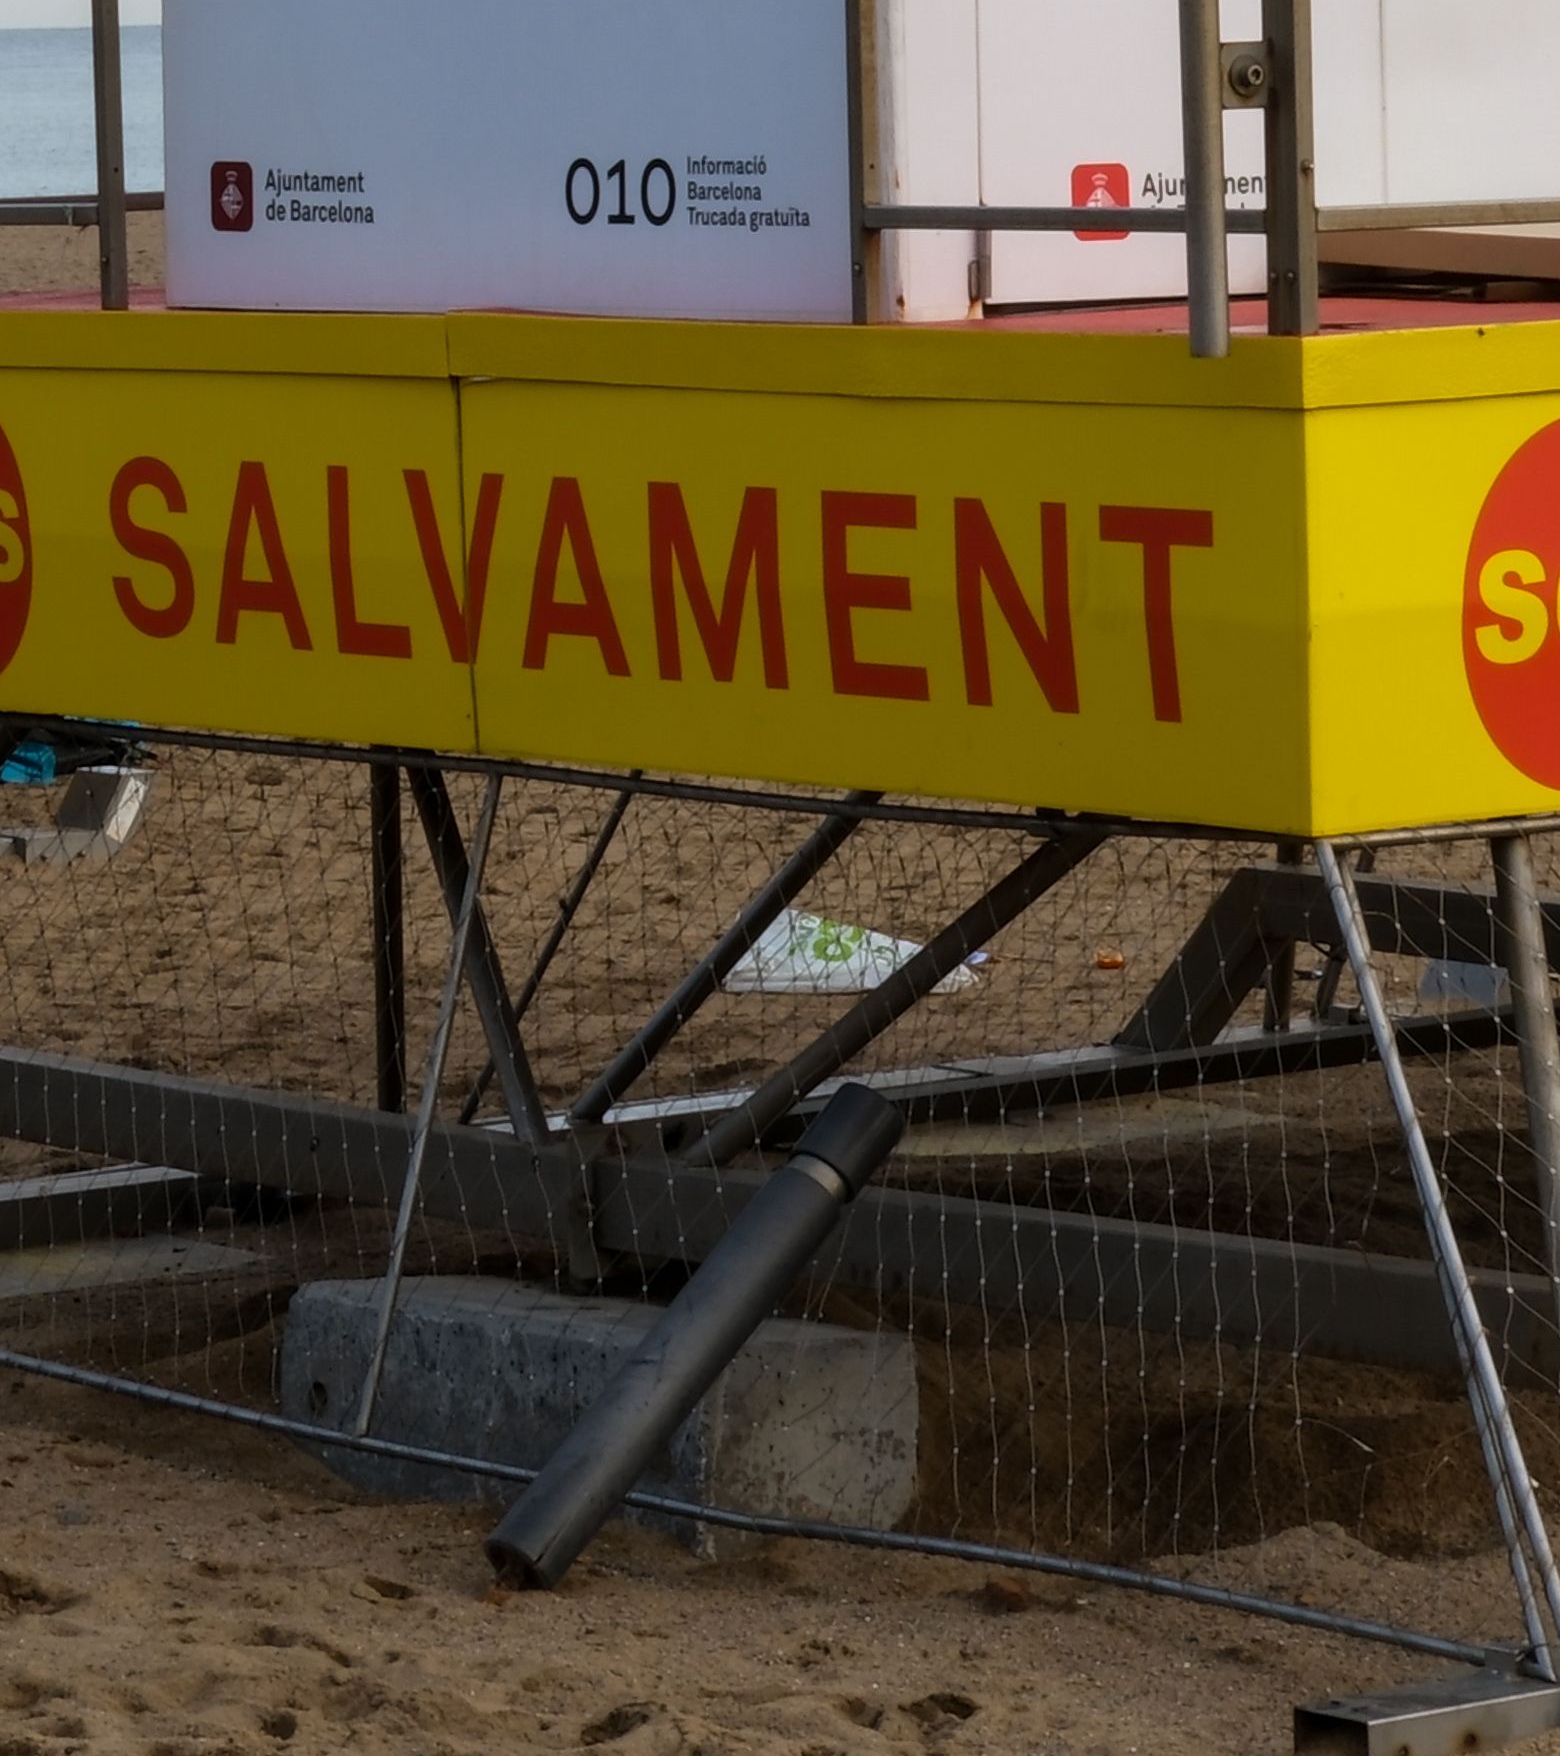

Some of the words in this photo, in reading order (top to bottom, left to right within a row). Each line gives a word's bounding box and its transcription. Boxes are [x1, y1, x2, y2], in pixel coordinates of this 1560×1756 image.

[686, 155, 767, 176] Informació
[264, 168, 365, 198] Ajuntament
[565, 157, 676, 226] 010
[687, 181, 762, 201] Barcelona
[266, 198, 286, 221] de
[290, 199, 375, 224] Barcelona
[686, 206, 747, 227] Trucada
[108, 454, 1215, 725] SALVAMENT
